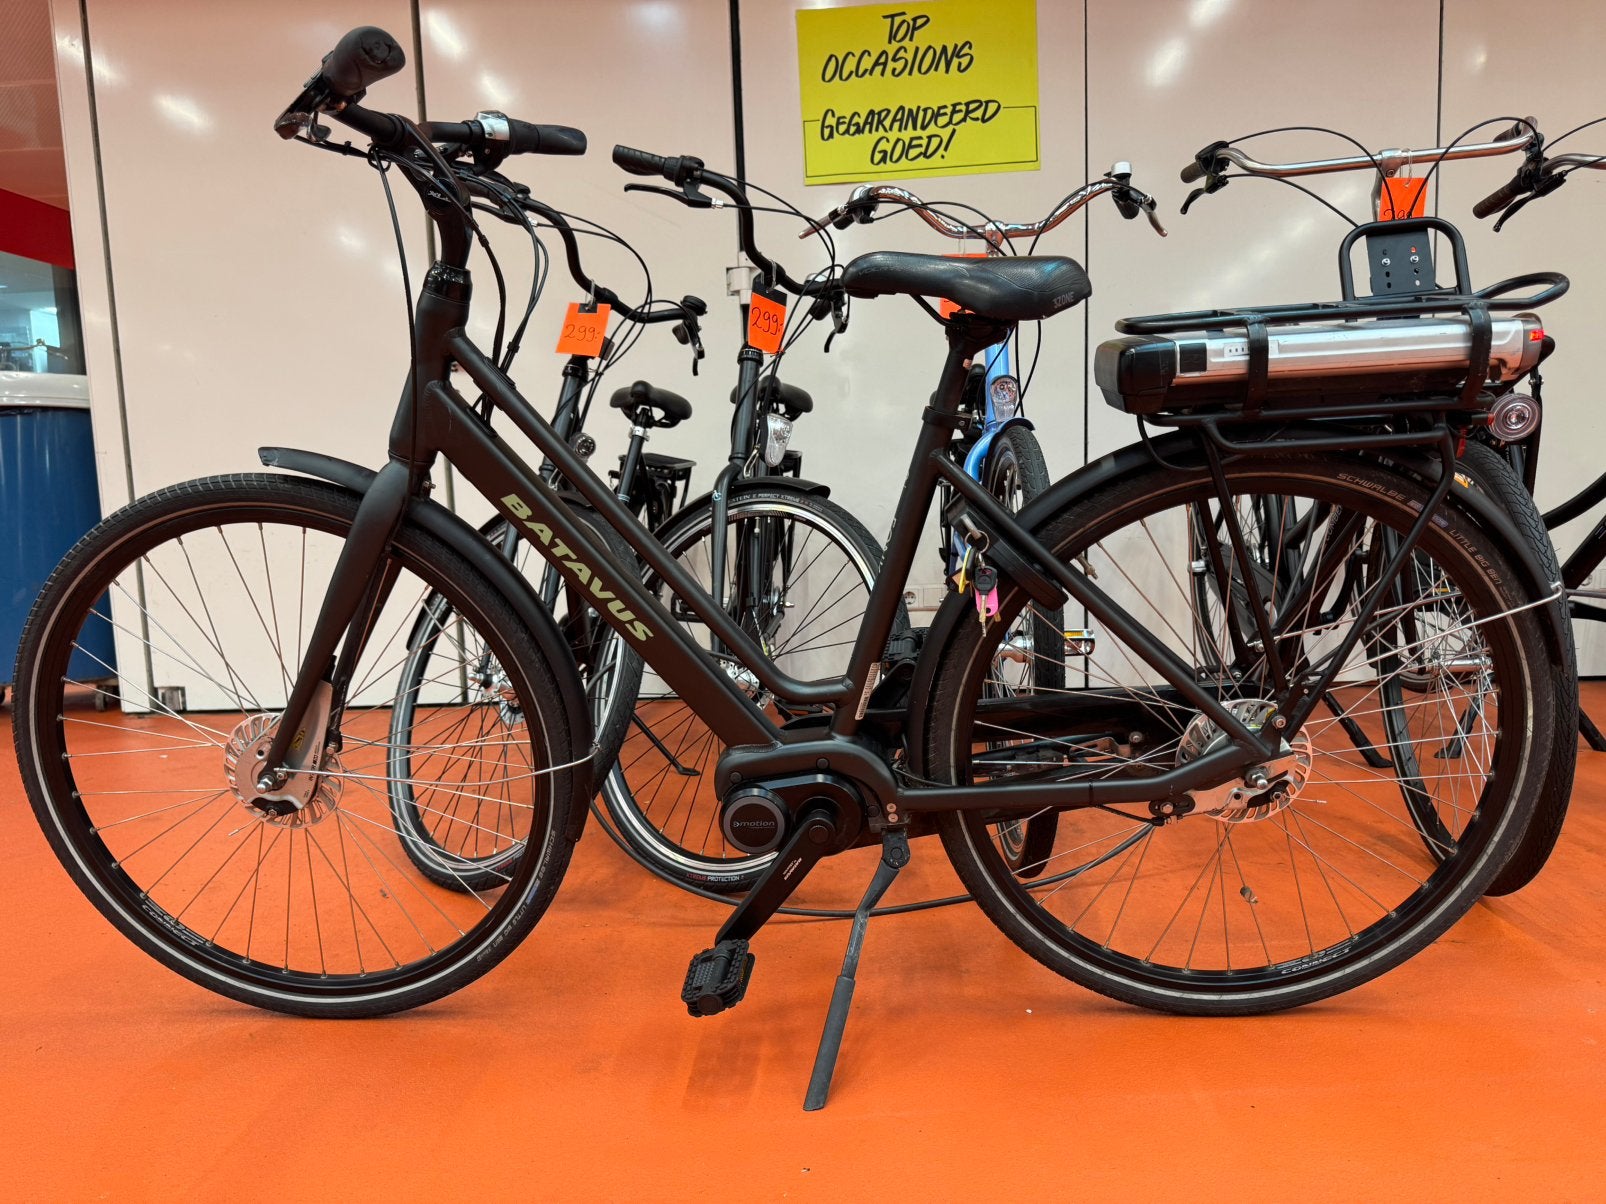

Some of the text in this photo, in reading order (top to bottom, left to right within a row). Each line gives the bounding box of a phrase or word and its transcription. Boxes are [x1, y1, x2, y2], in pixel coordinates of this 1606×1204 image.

[881, 11, 931, 45] TOP
[821, 40, 975, 83] OCCASIONS
[820, 99, 1002, 141] GEGARANDEERD
[870, 128, 957, 166] GOED!
[1336, 472, 1407, 501] SCHWALBE
[1449, 529, 1478, 553] LITTLE
[500, 493, 654, 642] BATAVUS
